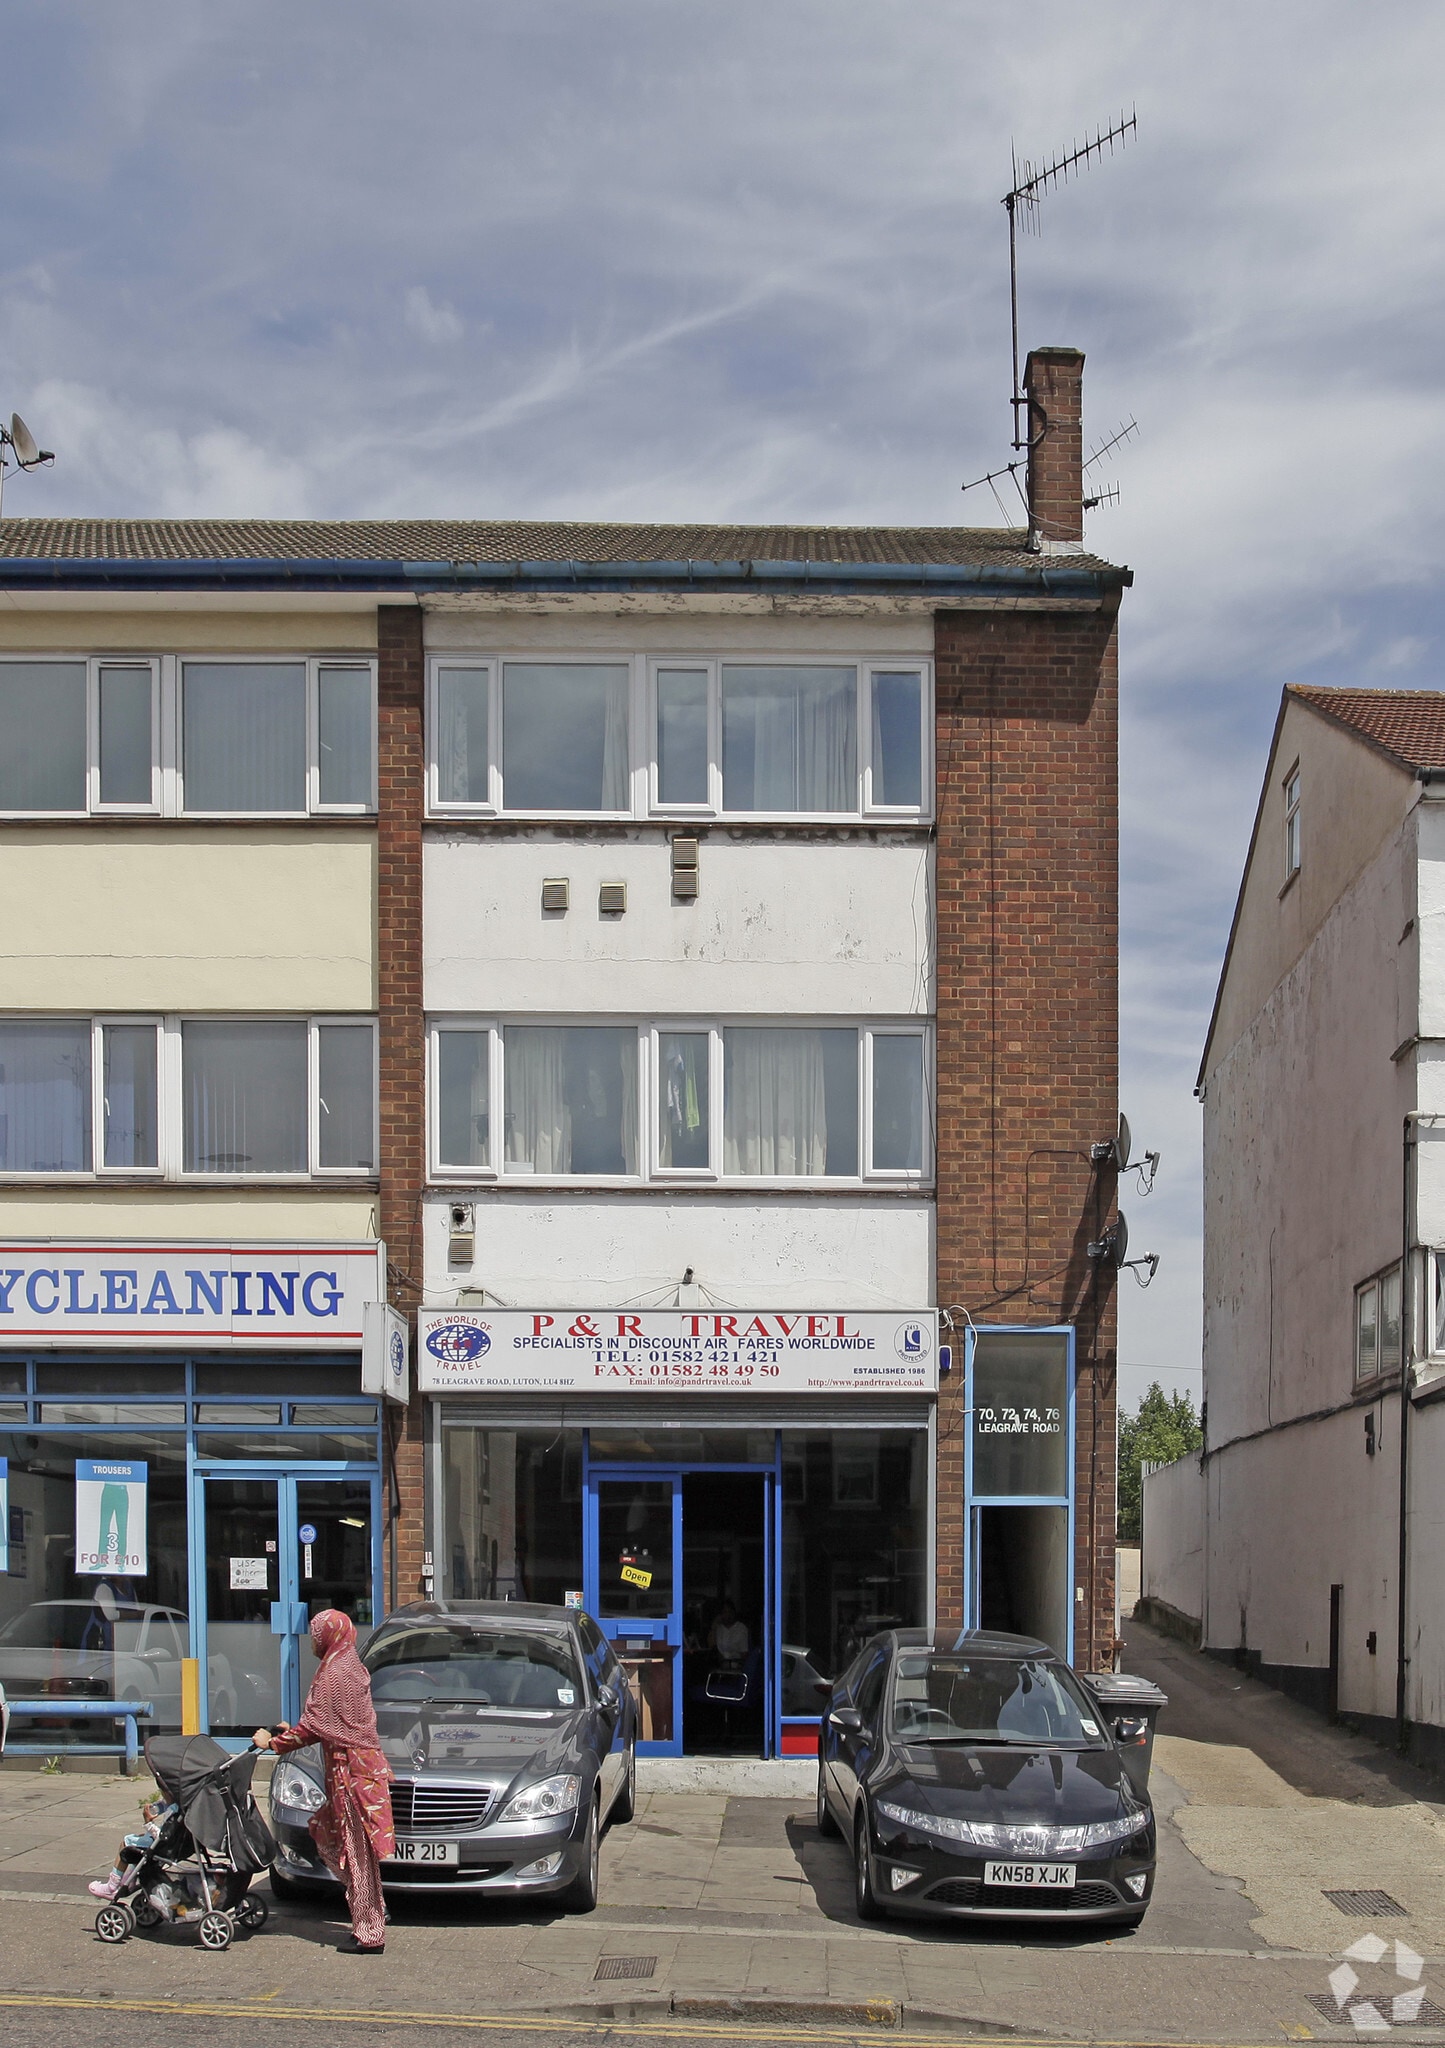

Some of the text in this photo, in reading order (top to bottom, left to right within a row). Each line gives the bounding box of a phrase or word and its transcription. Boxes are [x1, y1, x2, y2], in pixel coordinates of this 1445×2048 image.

[425, 1315, 493, 1332] THE WORLD OF
[530, 1315, 860, 1337] P & R TRAVEL
[513, 1337, 875, 1350] SPECIALISTS IN DISCOUNT AIR FARES WORLDWIDE
[592, 1351, 778, 1363] TEL: 01582 421 421
[898, 1349, 928, 1361] PROTECTED
[436, 1360, 482, 1371] TRAVEL
[594, 1365, 780, 1377] FAX: 01582 48 49 50
[486, 1378, 511, 1386] ROAD,
[513, 1378, 542, 1386] LUTON,
[657, 1378, 752, 1387] info@pandrtravel.co.uk
[808, 1378, 925, 1388] http://www.pandrtravel.co.uk
[978, 1408, 1060, 1422] 70, 72 74, 76
[978, 1423, 1060, 1433] LEAGRAVE ROAD
[92, 1465, 132, 1475] TROUSERS
[107, 1532, 119, 1552] 3
[81, 1553, 140, 1566] FOR £10
[625, 1569, 647, 1582] Open
[421, 1844, 447, 1860] 213
[992, 1865, 1069, 1883] KN58 XJK
